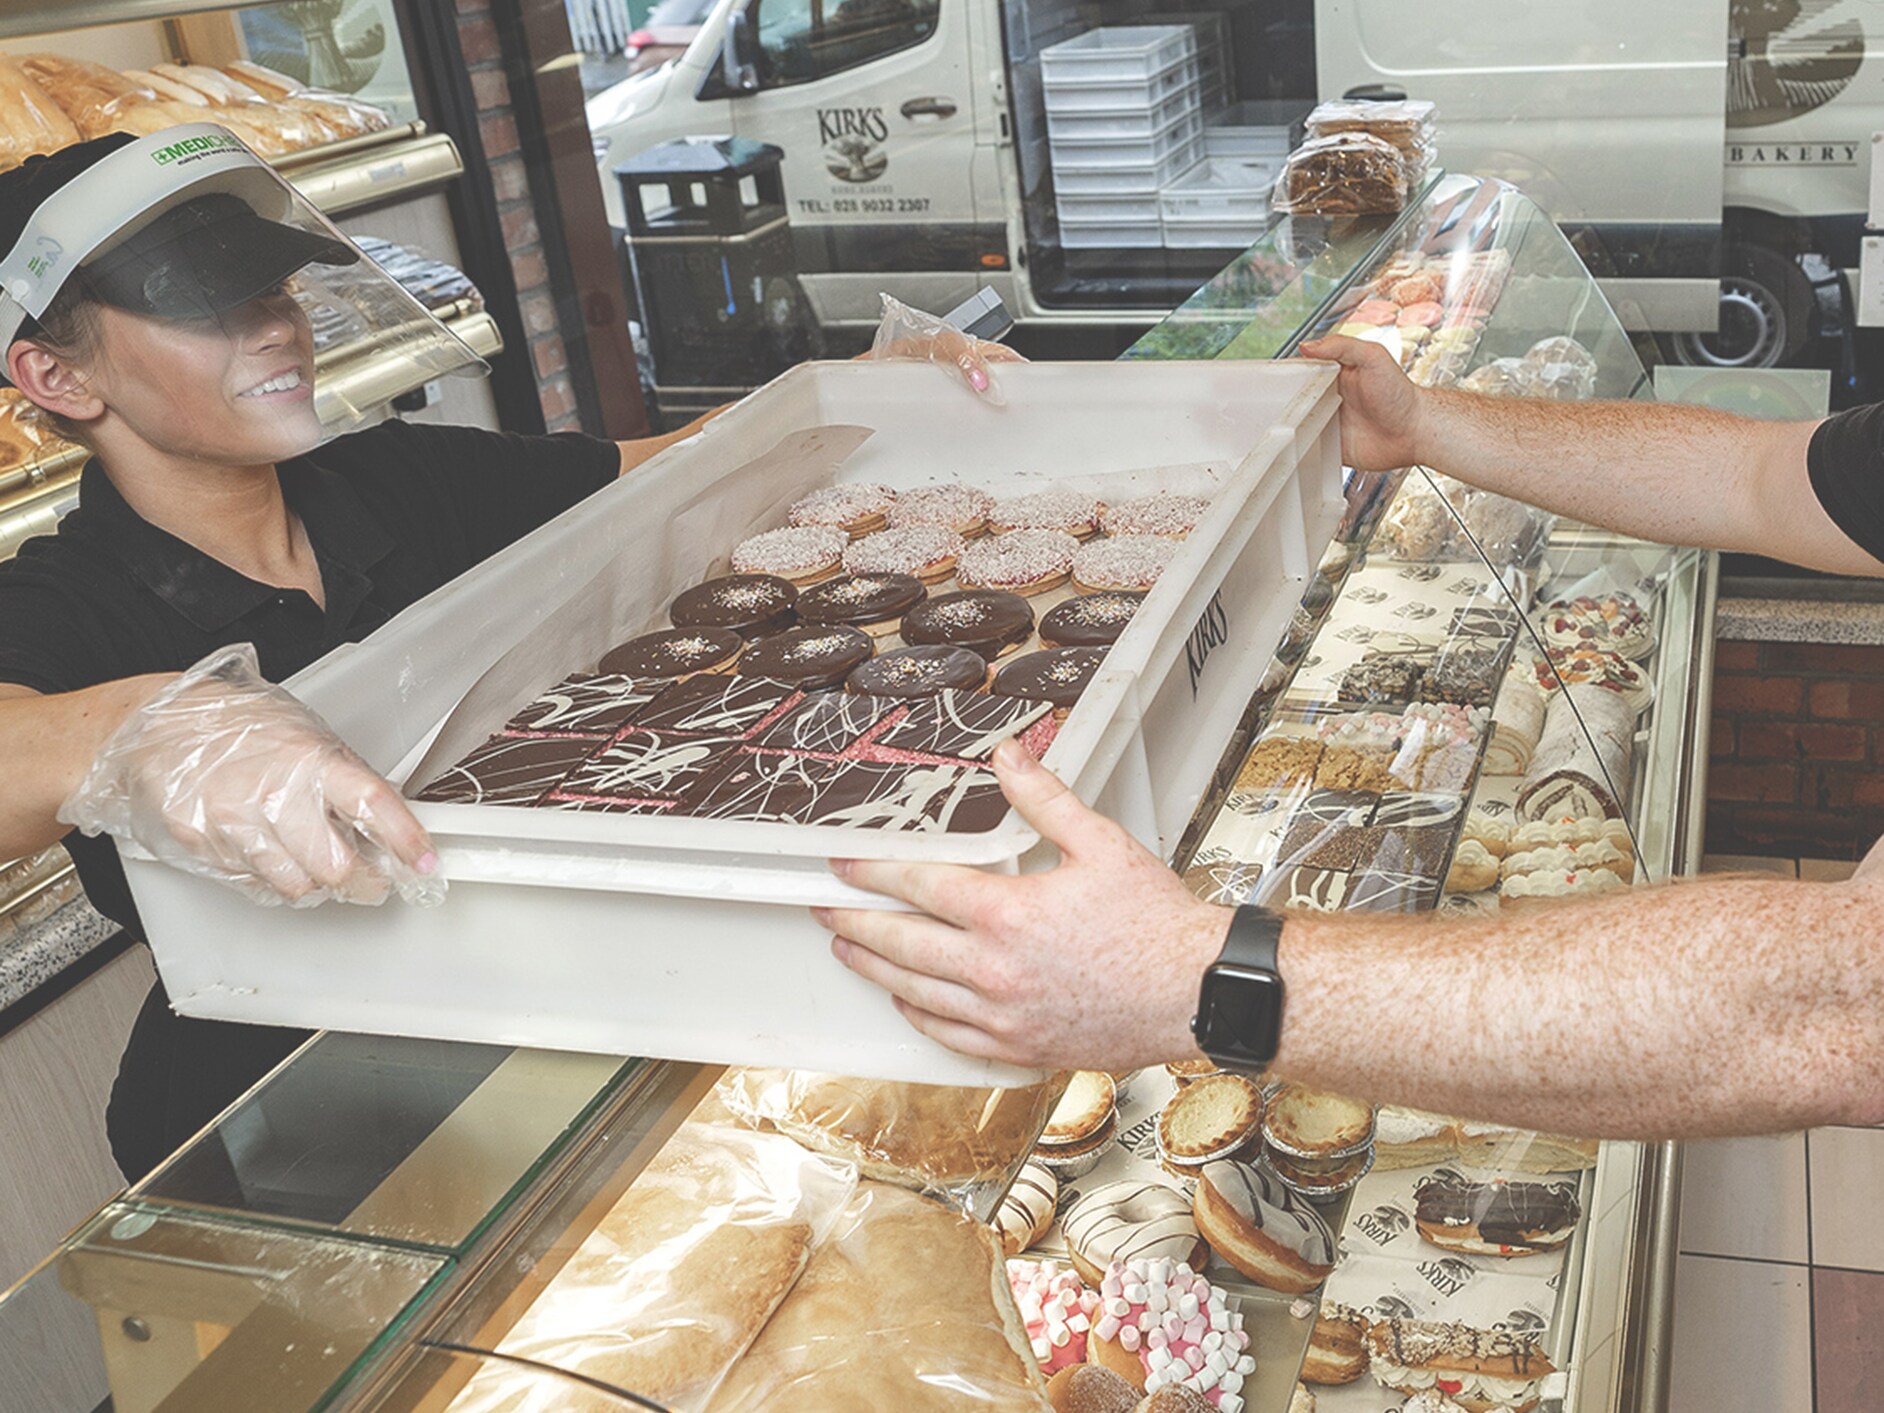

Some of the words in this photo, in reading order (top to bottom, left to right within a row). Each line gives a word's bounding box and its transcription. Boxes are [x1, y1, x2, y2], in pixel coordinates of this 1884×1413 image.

[817, 107, 889, 146] KIRKS
[1730, 145, 1858, 162] BAKERY
[798, 199, 830, 213] TEL:
[833, 199, 858, 213] 028
[861, 199, 894, 212] 9032
[897, 198, 931, 212] 2307
[1185, 587, 1228, 703] KIRKS
[1193, 845, 1233, 866] IRKS
[1116, 1110, 1161, 1153] KIRK
[1353, 1213, 1399, 1247] KIRKS
[1416, 1260, 1466, 1298] KIRKS
